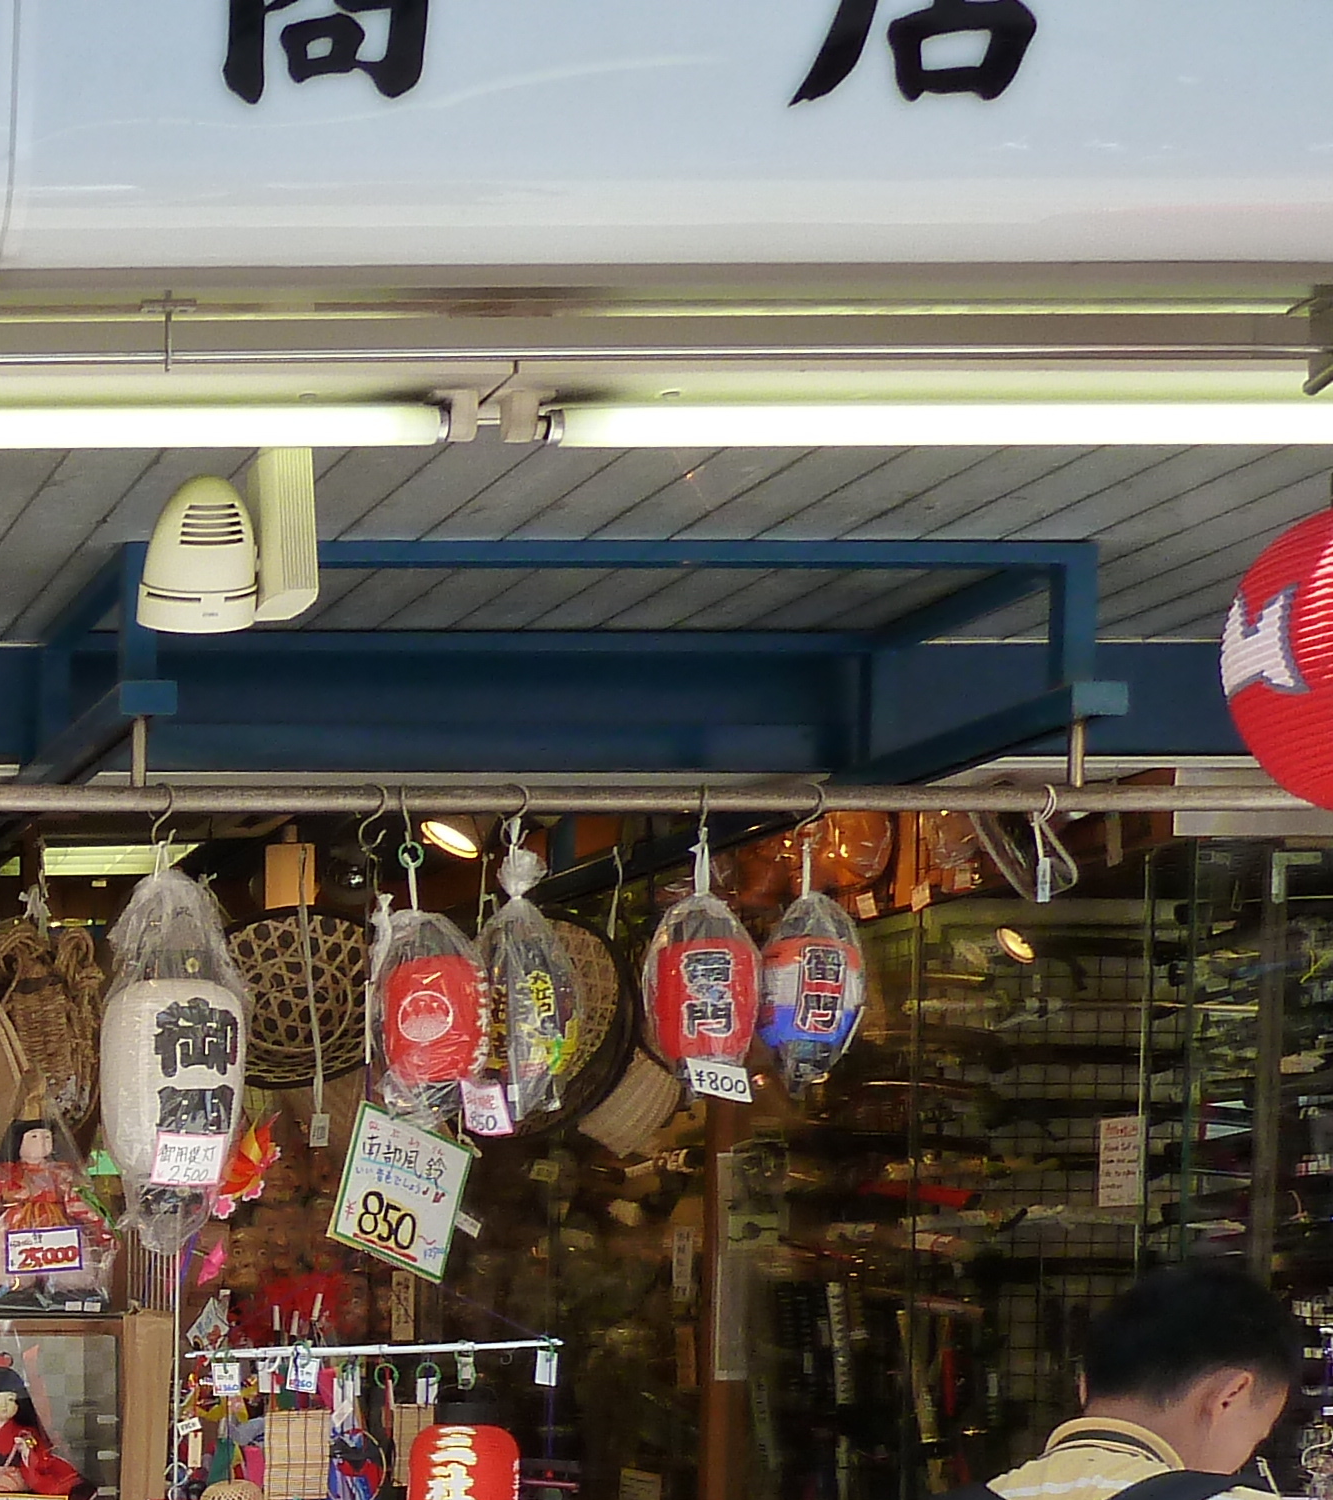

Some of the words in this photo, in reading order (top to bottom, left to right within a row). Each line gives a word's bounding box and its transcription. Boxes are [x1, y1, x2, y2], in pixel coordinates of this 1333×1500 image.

[682, 949, 734, 1038] 雷門
[694, 1069, 747, 1093] ¥800
[362, 1136, 448, 1185] 南部風鈴
